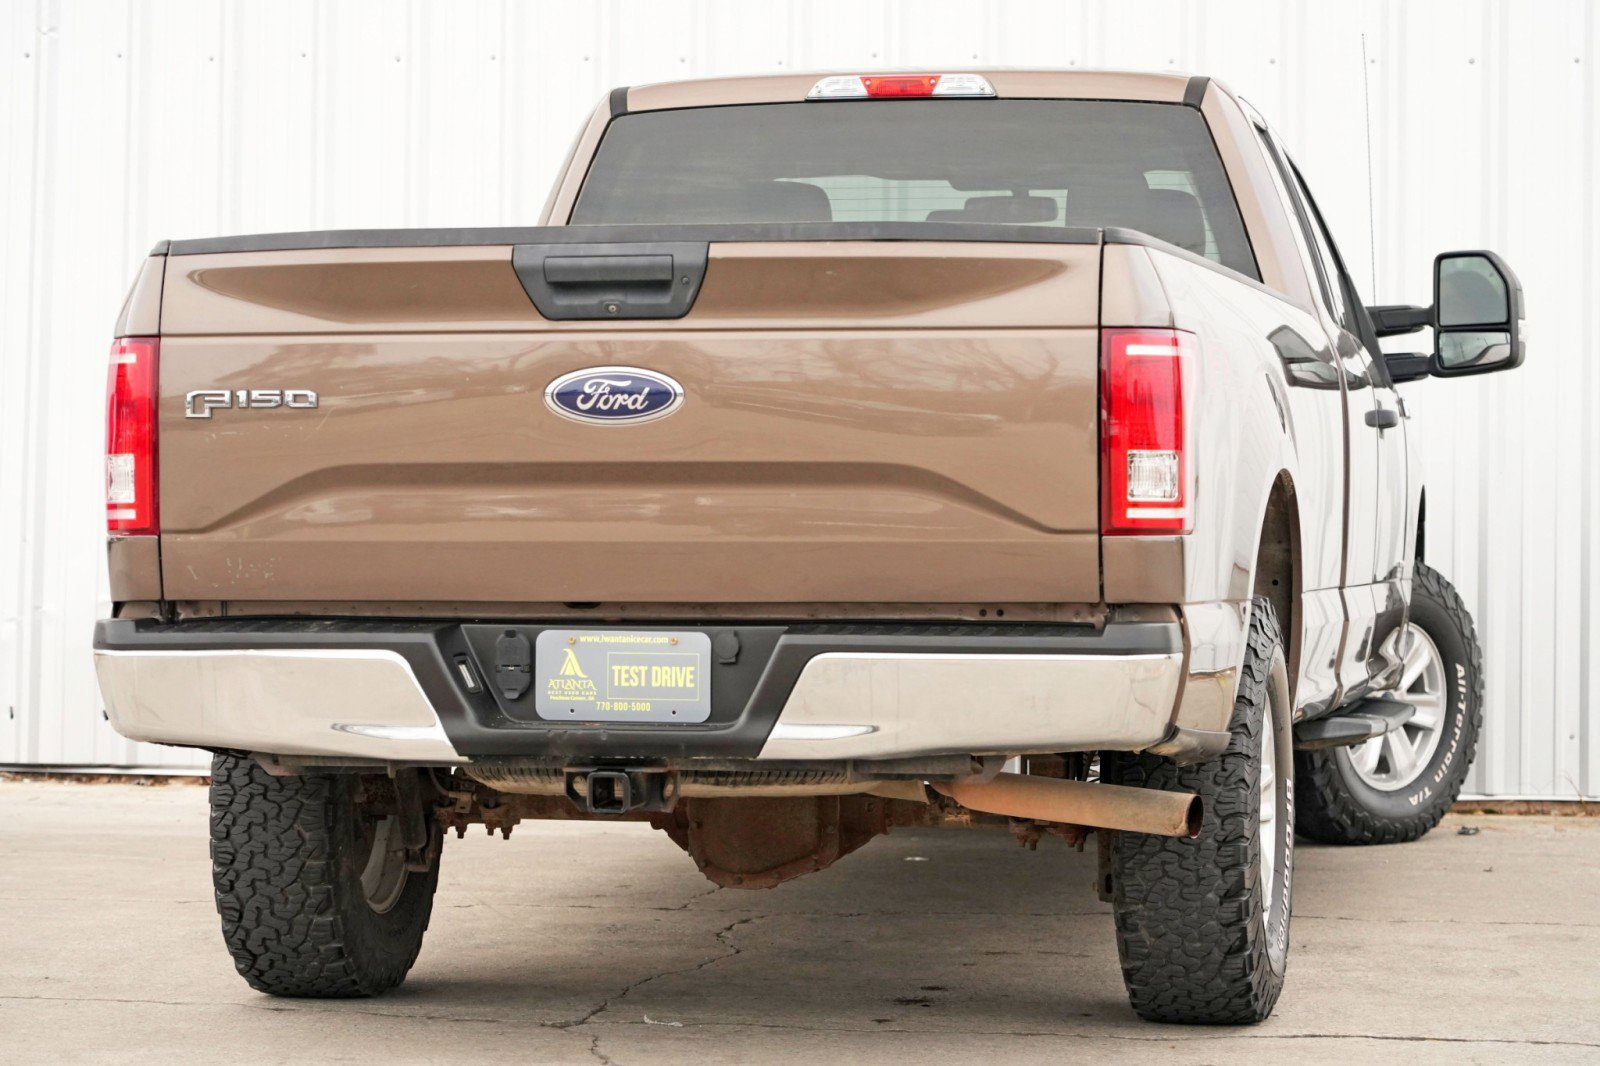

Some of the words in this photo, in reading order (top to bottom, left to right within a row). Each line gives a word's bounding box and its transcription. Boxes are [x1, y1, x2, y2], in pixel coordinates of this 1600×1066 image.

[576, 378, 650, 410] Ford
[580, 635, 669, 644] www.iwantanicecar.com
[548, 679, 597, 690] ATLANTA
[612, 665, 648, 687] TEST
[651, 666, 695, 688] DRIVE
[596, 701, 651, 712] 770-800-5000
[1434, 663, 1467, 783] All-Terrain
[1408, 786, 1433, 807] T/A
